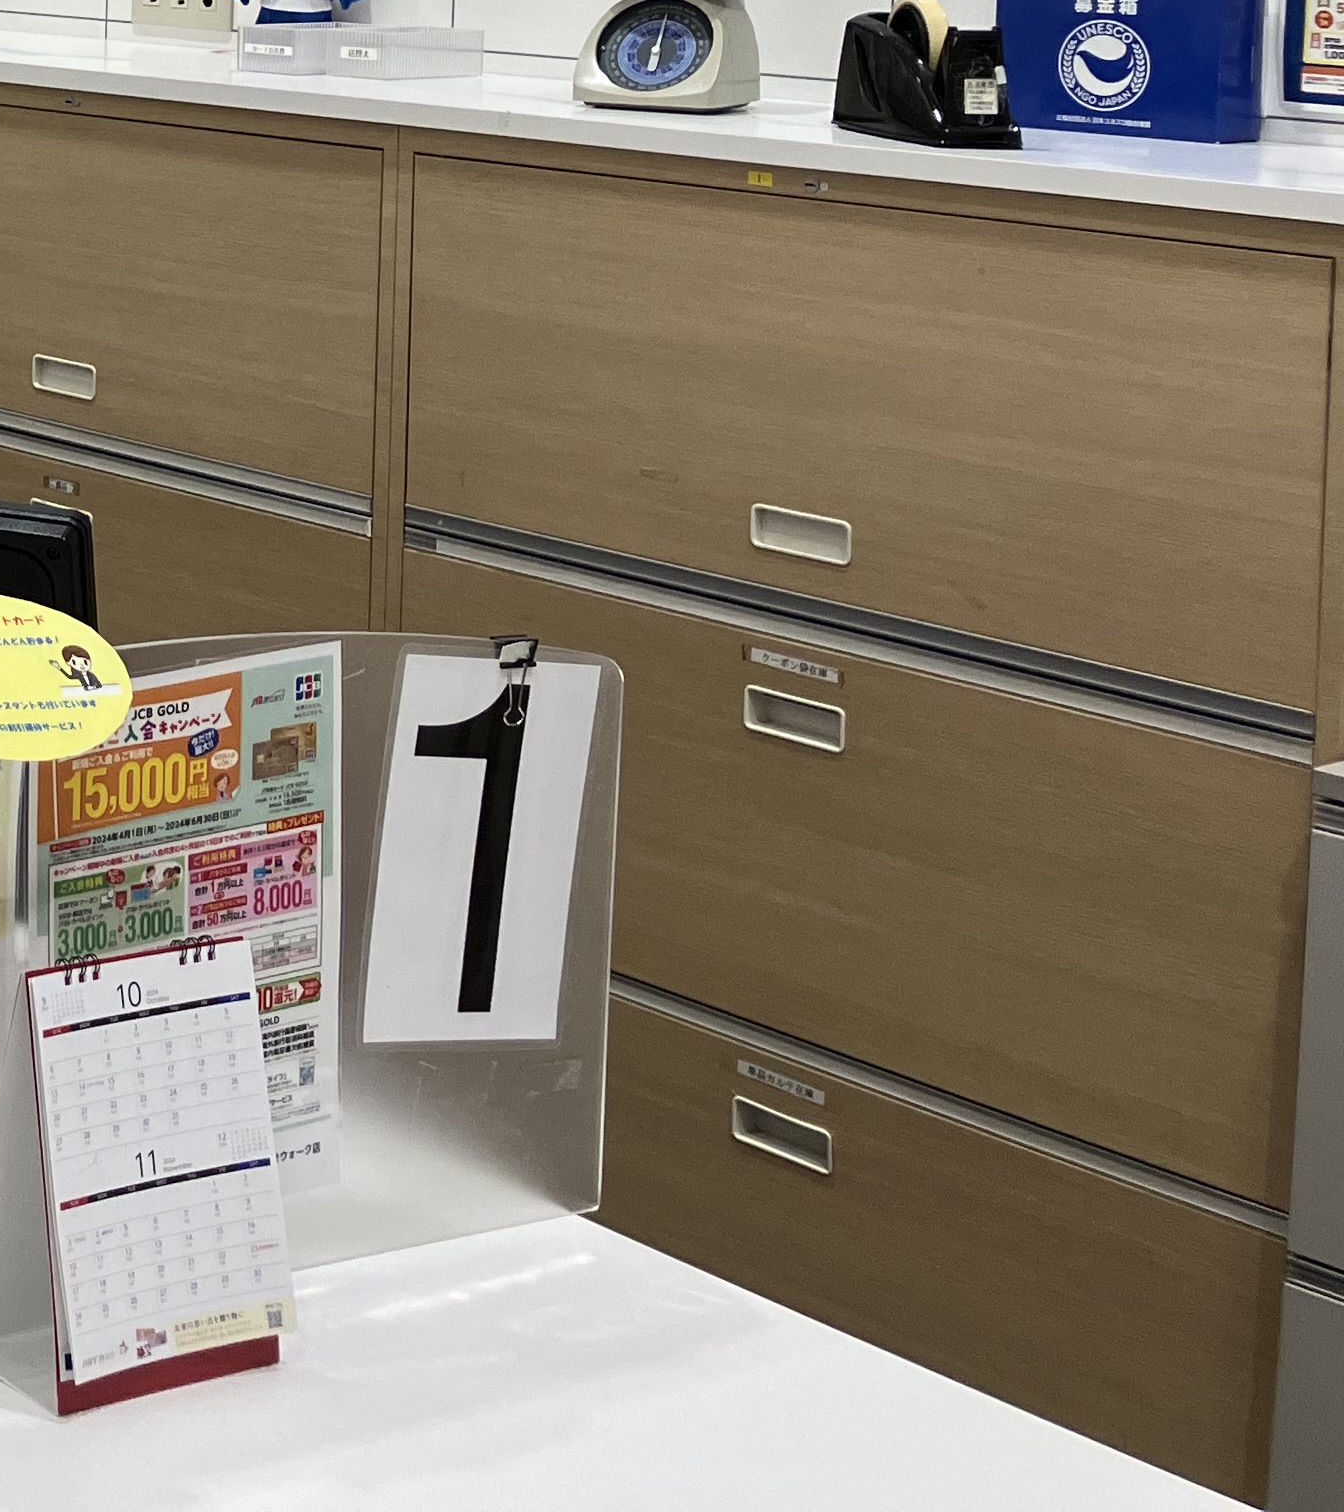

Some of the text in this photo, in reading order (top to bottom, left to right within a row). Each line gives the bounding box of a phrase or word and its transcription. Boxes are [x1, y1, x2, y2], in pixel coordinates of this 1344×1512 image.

[1076, 23, 1134, 44] UNESCO
[1074, 86, 1132, 107] NGO JAPAN
[131, 701, 190, 722] JCB GOLD
[186, 782, 209, 800] 相当
[414, 680, 532, 1014] 1
[124, 907, 174, 943] 3,000
[253, 879, 302, 915] 8,000
[116, 981, 142, 1009] 10
[134, 1149, 157, 1178] 11
